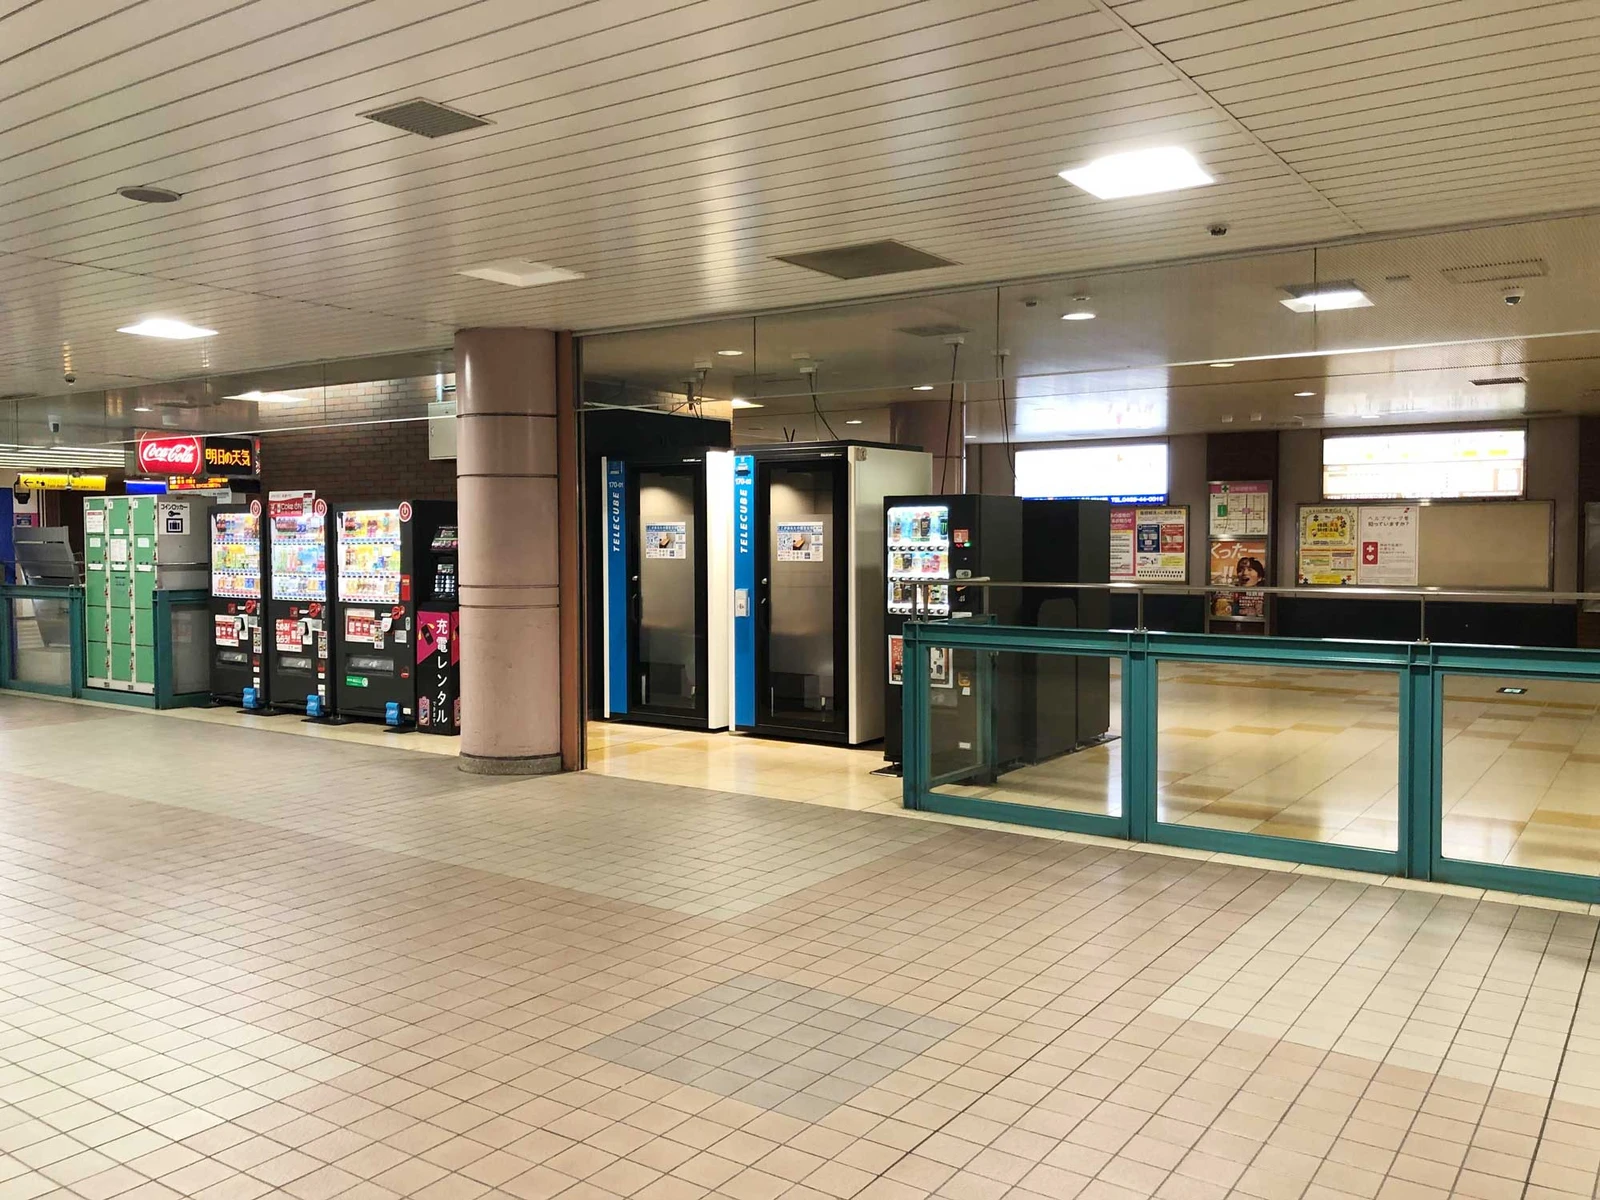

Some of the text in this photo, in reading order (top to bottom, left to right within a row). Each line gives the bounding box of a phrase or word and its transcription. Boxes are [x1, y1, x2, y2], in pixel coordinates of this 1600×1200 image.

[205, 448, 250, 466] 明日の天気
[612, 491, 621, 553] TELECUBE
[739, 488, 749, 554] TELECUBE
[436, 618, 448, 724] 充電レンタル
